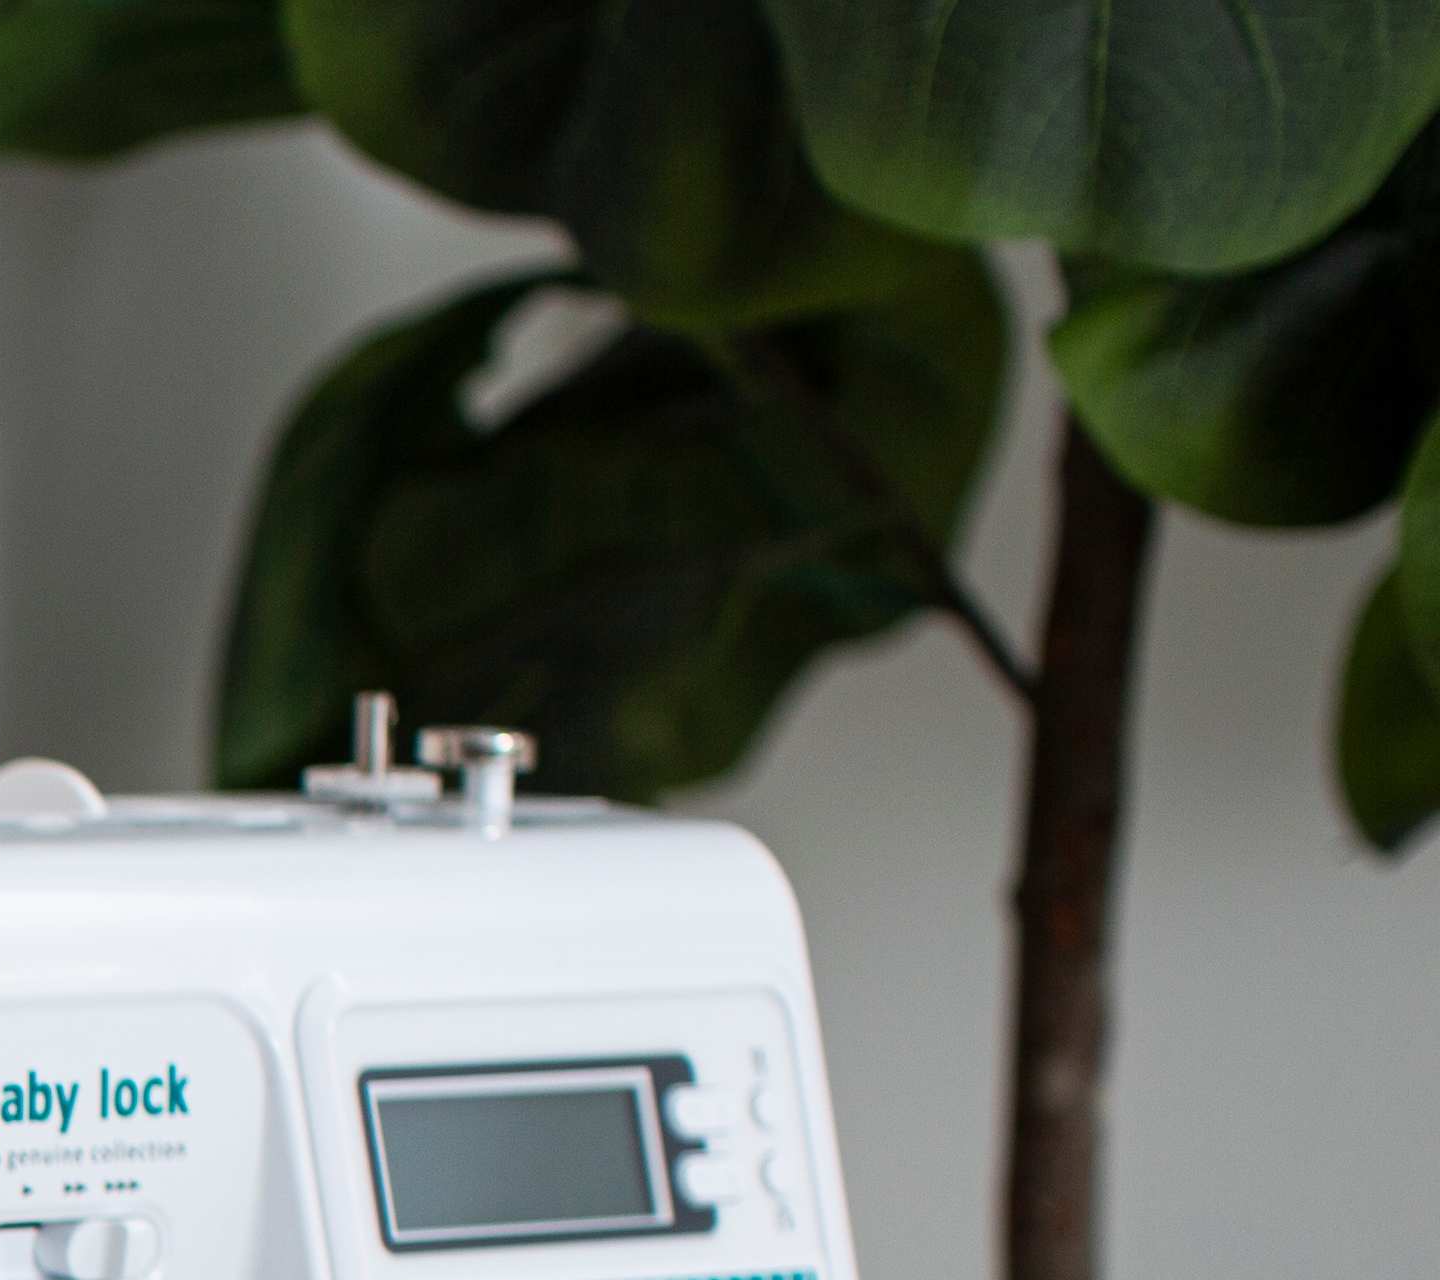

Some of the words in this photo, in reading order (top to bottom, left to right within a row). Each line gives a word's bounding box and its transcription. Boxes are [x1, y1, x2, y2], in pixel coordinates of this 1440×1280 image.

[100, 1063, 188, 1119] lock
[7, 1148, 83, 1170] genuine
[91, 1141, 187, 1162] collection
